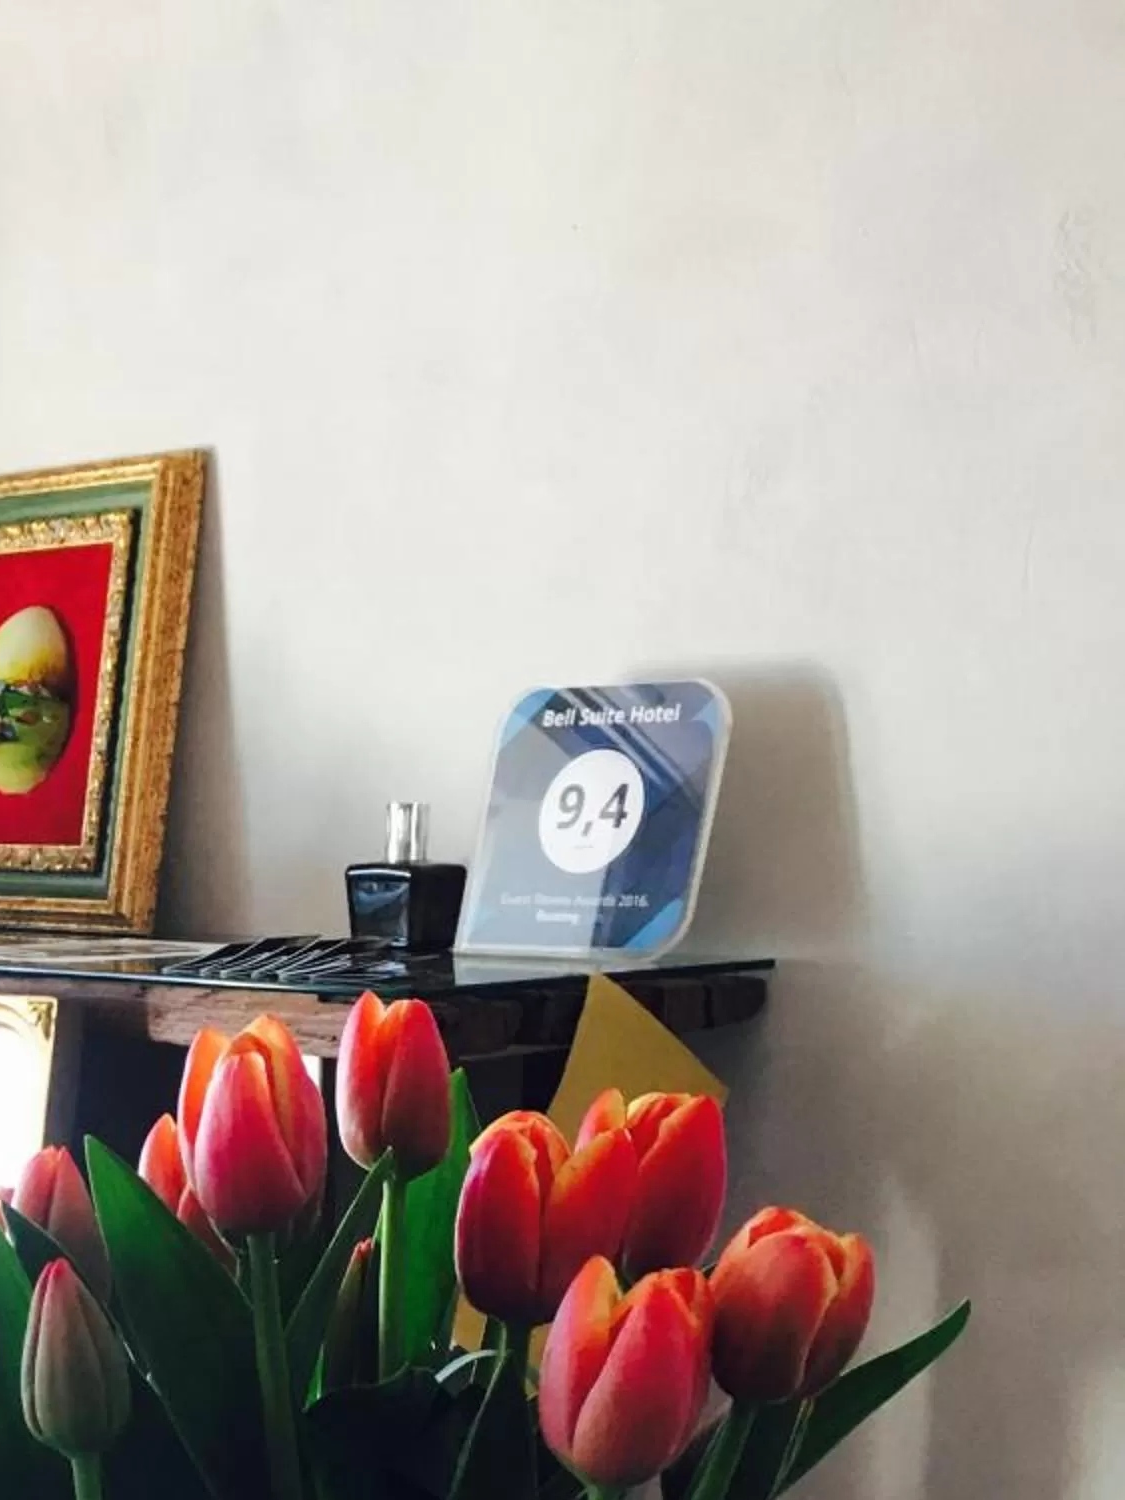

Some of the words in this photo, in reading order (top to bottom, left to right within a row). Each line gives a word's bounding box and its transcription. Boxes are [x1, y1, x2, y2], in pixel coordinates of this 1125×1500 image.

[542, 708, 576, 728] Bell
[578, 705, 625, 726] Suite
[630, 703, 682, 724] Hotel
[556, 783, 630, 838] 9,4
